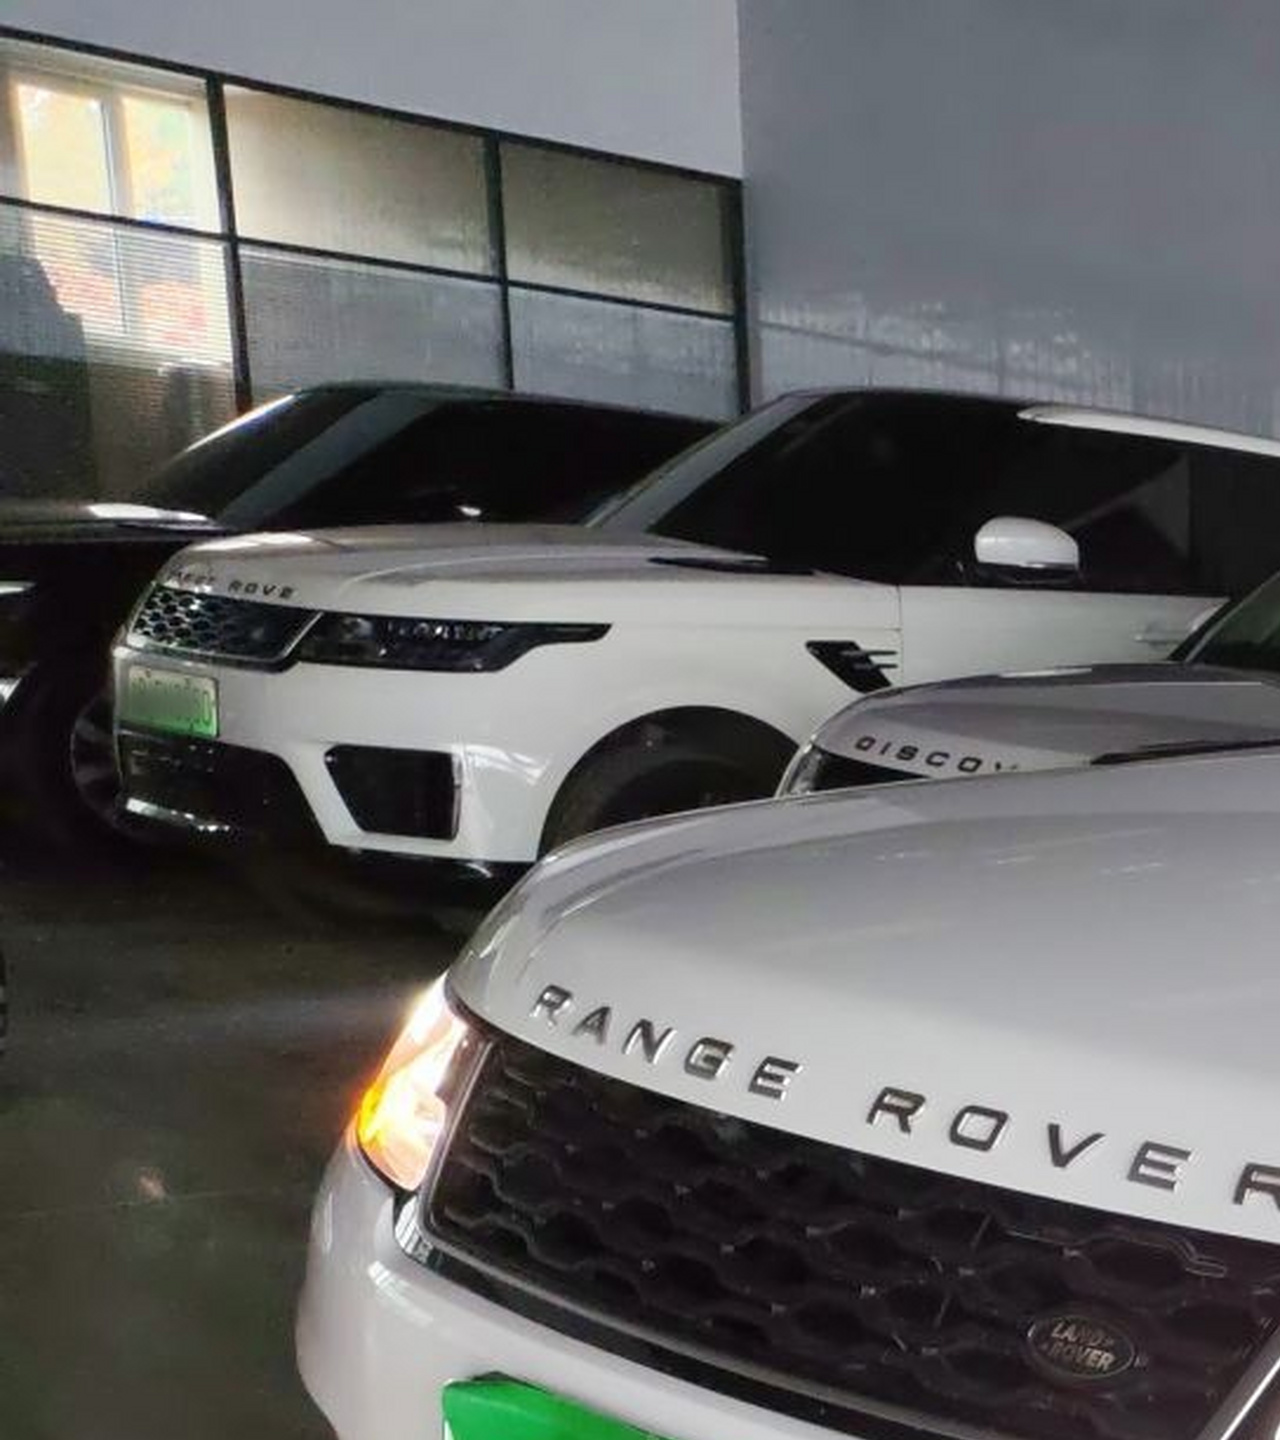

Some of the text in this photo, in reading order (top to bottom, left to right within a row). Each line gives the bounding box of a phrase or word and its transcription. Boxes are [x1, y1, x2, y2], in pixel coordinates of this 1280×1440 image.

[529, 983, 803, 1100] RANGE
[1050, 1321, 1108, 1347] LAND
[1049, 1341, 1117, 1370] ROVER
